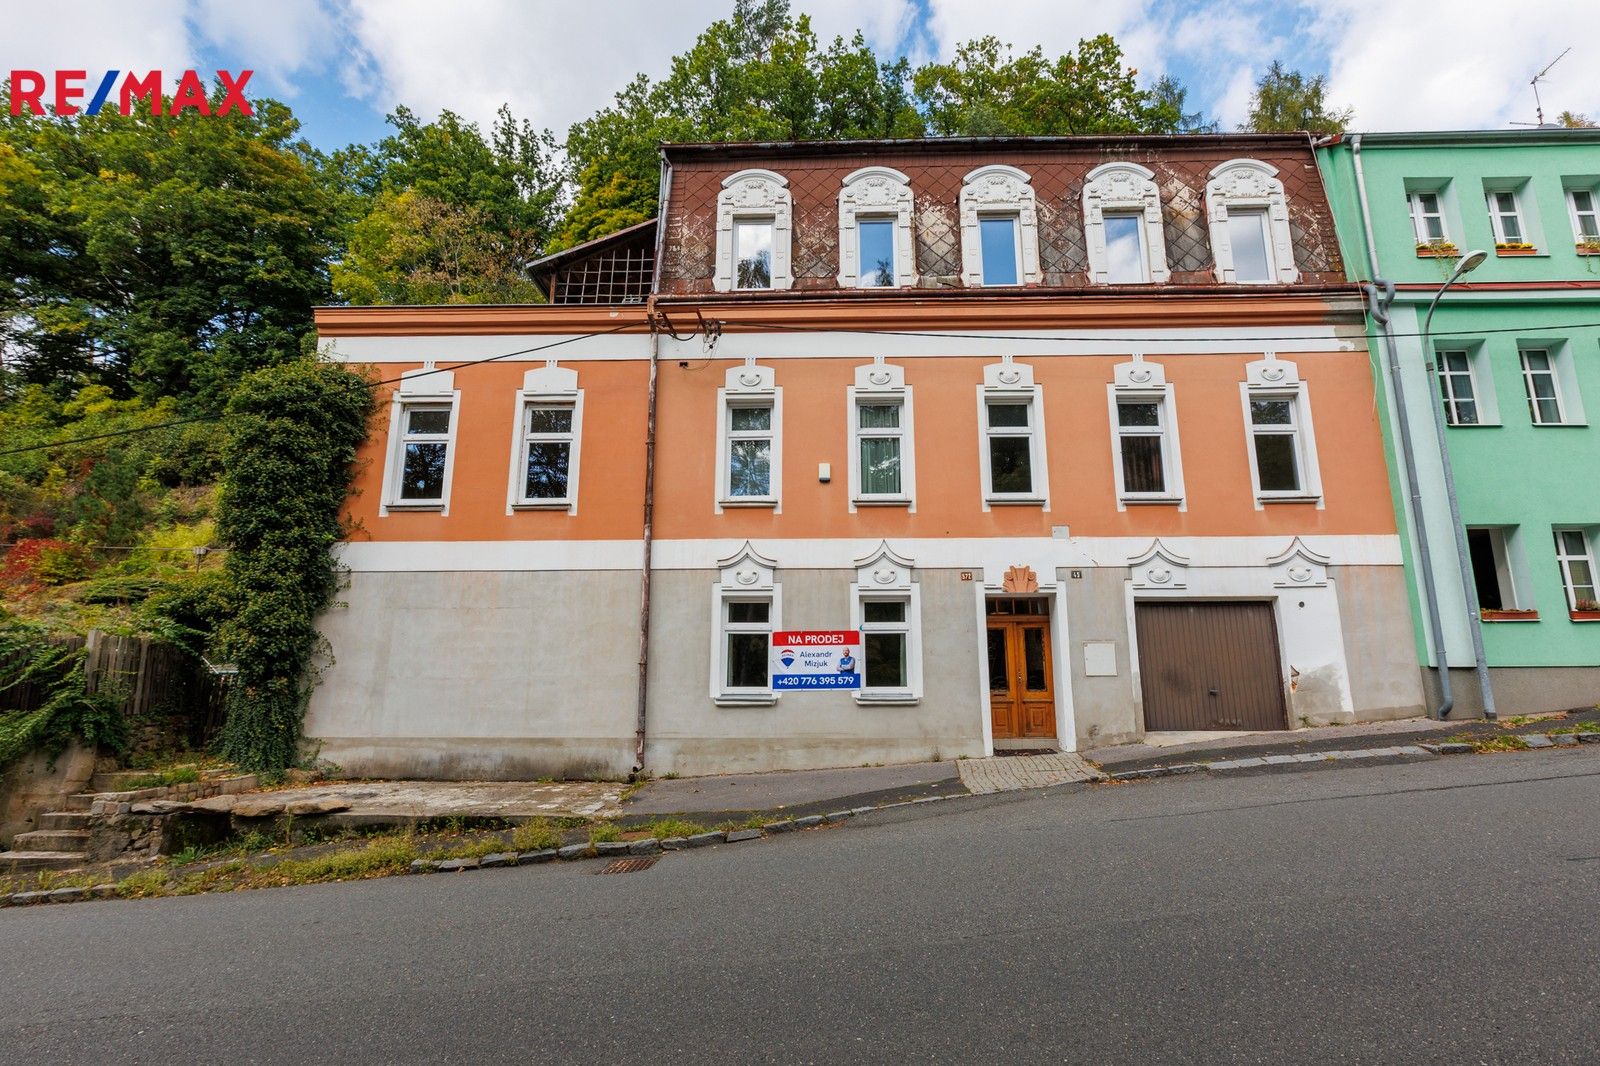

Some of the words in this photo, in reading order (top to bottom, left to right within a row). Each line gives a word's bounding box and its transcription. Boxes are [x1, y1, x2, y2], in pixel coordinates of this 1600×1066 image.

[788, 635, 803, 644] NA
[805, 634, 844, 644] PRODEJ
[804, 660, 828, 668] Mizjuk
[777, 677, 799, 686] +420
[801, 677, 817, 685] 776
[819, 677, 836, 685] 395
[838, 676, 854, 685] 579
